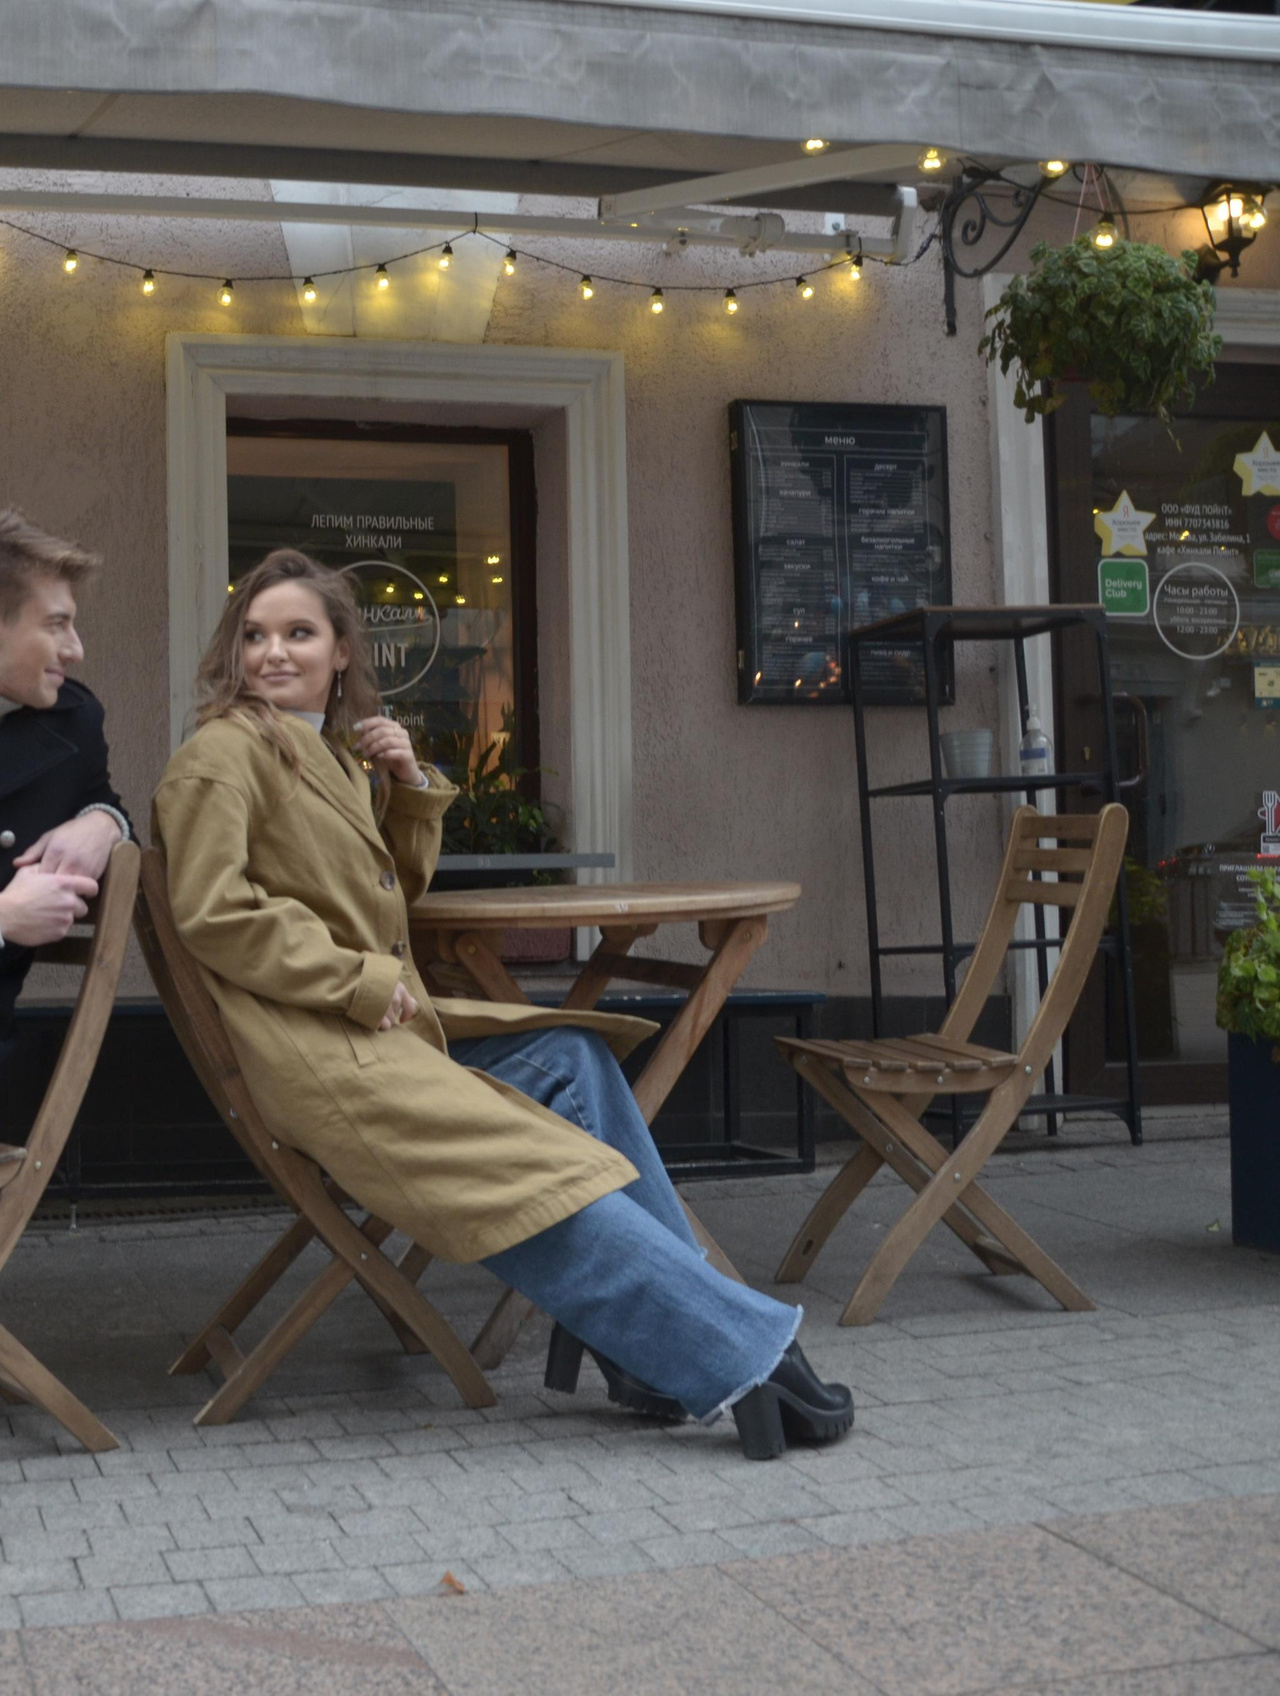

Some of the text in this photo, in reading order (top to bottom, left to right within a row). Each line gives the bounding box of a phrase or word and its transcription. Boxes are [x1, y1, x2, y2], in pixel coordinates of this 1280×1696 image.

[310, 514, 435, 531] ЛЕПИМ ПРАВИЛЬНЫЕ
[345, 534, 402, 549] ХИНКАЛИ
[1104, 578, 1142, 589] Delivery
[1105, 588, 1127, 598] Club
[1164, 584, 1229, 598] Часы работы
[373, 642, 409, 668] INT
